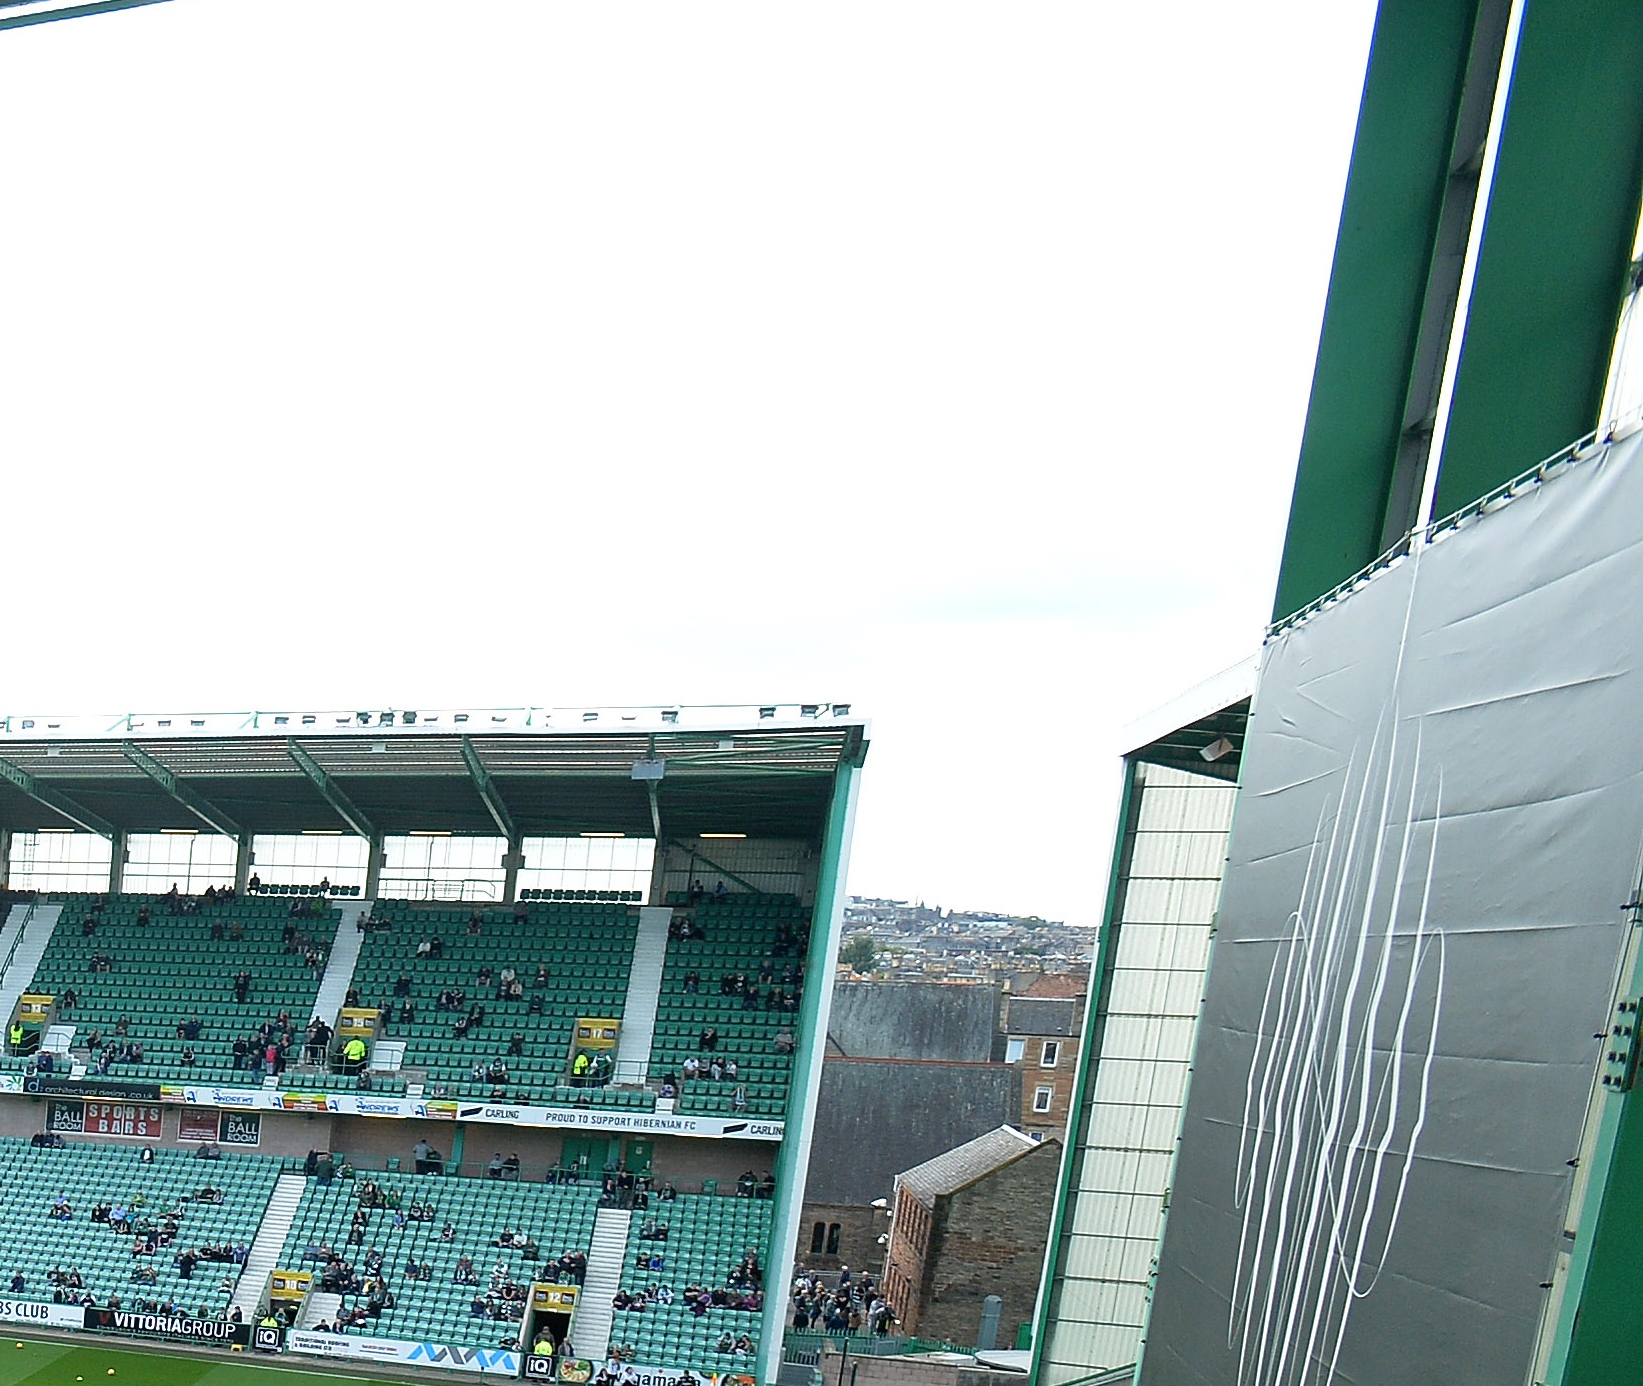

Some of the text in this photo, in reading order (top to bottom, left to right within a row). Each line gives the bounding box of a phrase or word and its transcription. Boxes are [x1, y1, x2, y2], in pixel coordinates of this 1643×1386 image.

[99, 1089, 126, 1099] design
[55, 1111, 82, 1122] BALL
[89, 1104, 158, 1121] SPORTS
[485, 1109, 696, 1130] CARLING PROUD TO SUPPORT HIBERNIAN FC
[53, 1121, 81, 1130] ROOM
[99, 1120, 147, 1135] BARS
[227, 1123, 257, 1134] BALL
[750, 1125, 782, 1135] CARLIN
[227, 1133, 256, 1142] ROOM
[16, 1303, 49, 1319] CLUB
[114, 1311, 236, 1338] VITTORIAGROUP
